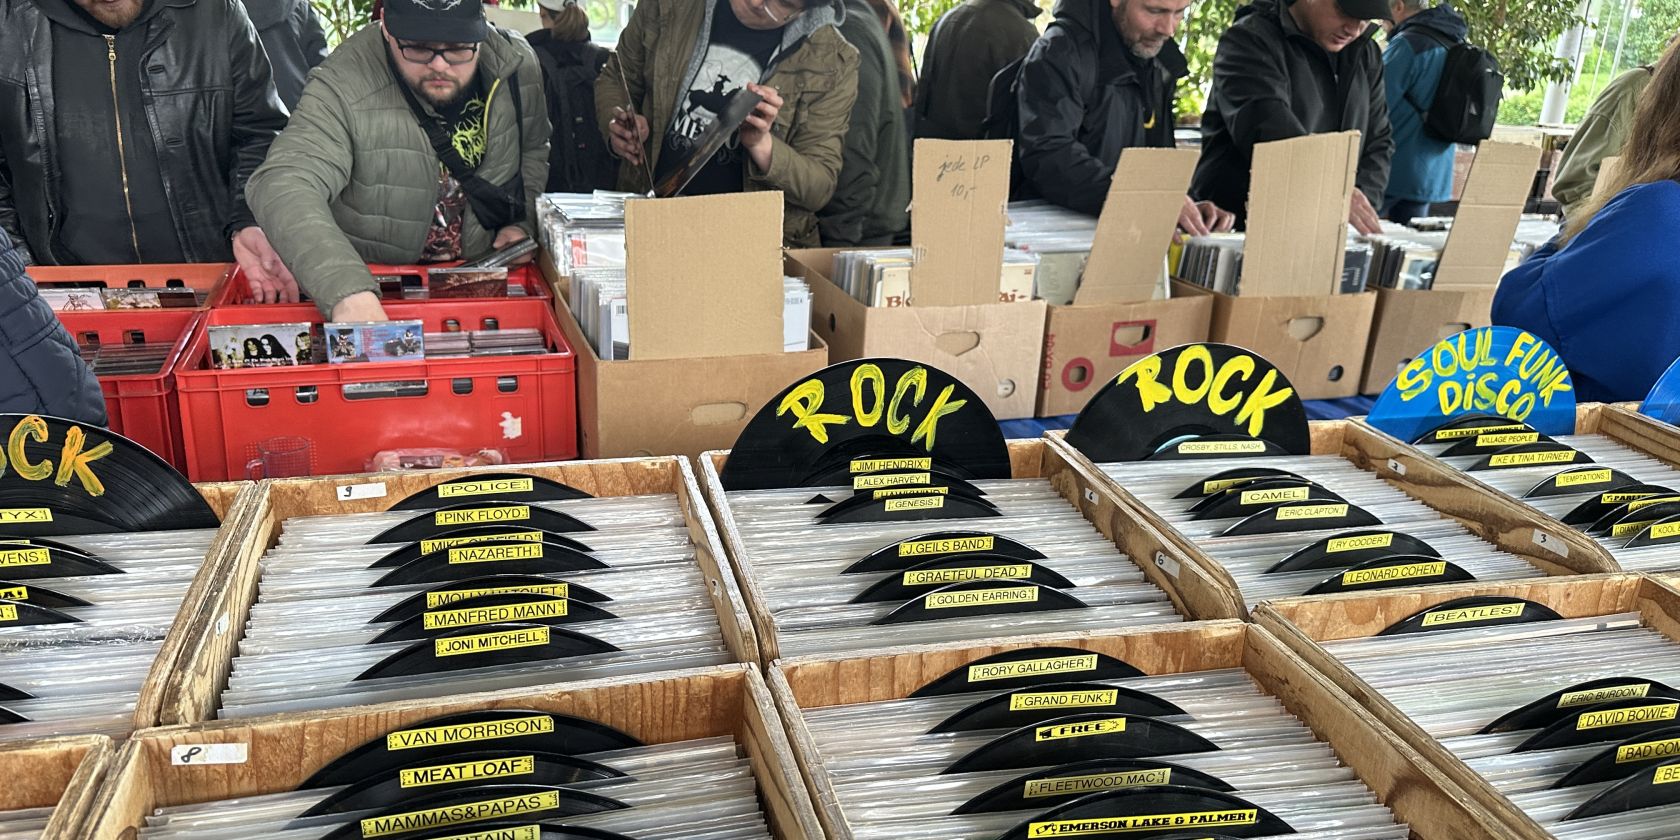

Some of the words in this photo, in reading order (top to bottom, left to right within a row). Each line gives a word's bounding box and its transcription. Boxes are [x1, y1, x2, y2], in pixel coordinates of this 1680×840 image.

[936, 154, 965, 182] jede
[973, 154, 990, 170] LP
[1396, 328, 1497, 401] SOUL
[1504, 332, 1572, 407] FUNK
[1116, 345, 1293, 437] ROCK
[776, 363, 967, 451] ROCK
[1481, 435, 1508, 444] VILLAGE
[1509, 434, 1533, 442] PEOPLE
[0, 415, 113, 497] CK
[1495, 456, 1508, 464] IKE
[1509, 455, 1516, 463] &
[1518, 453, 1535, 462] TINA
[1537, 452, 1569, 461] TURNER
[856, 462, 876, 471] JIMI
[879, 459, 923, 470] HENDRIX
[863, 477, 884, 486] ALEX
[886, 475, 921, 485] HARVEY
[1563, 472, 1605, 484] TEMPTATIONS
[450, 480, 522, 494] POLICE
[895, 498, 934, 508] GENESIS
[1250, 490, 1300, 501] CAMEL
[444, 510, 475, 523] PINK
[478, 507, 521, 521] FLOYD
[1285, 509, 1302, 517] ERIC
[1304, 506, 1339, 516] CLAPTON
[1658, 525, 1676, 534] KOOL
[1336, 539, 1348, 549] RY
[1349, 537, 1383, 548] COODER
[1541, 533, 1546, 543] 3
[458, 546, 532, 561] NAZARETH
[906, 541, 949, 555] J.GEILS
[953, 539, 985, 551] BAND
[1158, 554, 1164, 565] 6
[916, 569, 981, 583] GRAETFUL
[984, 567, 1017, 579] DEAD
[1350, 567, 1399, 583] LEONARD
[1401, 564, 1437, 578] COHEN
[937, 592, 978, 605] GOLDEN
[982, 589, 1027, 602] EARRING
[435, 607, 509, 626] MANFRED
[513, 601, 556, 617] MANN
[1434, 605, 1512, 622] BEATLES
[445, 640, 474, 653] JONI
[478, 631, 539, 648] MITCHELL
[982, 664, 1013, 677] RORY
[1017, 658, 1084, 674] GALLAGHER
[1024, 694, 1068, 707] GRAND
[1071, 692, 1103, 704] FUNK
[1570, 692, 1594, 704] ERIC
[1595, 687, 1637, 701] BURDON
[1586, 712, 1626, 727] DAVID
[1628, 706, 1668, 721] BOWIE
[400, 733, 437, 746] VAN
[444, 719, 541, 741] MORRISON
[1059, 721, 1107, 735] FREE
[181, 746, 201, 763] 8
[1626, 745, 1652, 760] BAD
[414, 765, 467, 783] MEAT
[473, 759, 522, 777] LOAF
[1039, 776, 1123, 793] FLEETWOOD
[1125, 772, 1156, 785] MAC
[375, 796, 541, 832] MAMMAS&PAPAS
[1058, 818, 1127, 833] EMERSON
[1132, 817, 1171, 829] LAKE
[1175, 816, 1185, 826] &
[1188, 812, 1247, 825] PALMER
